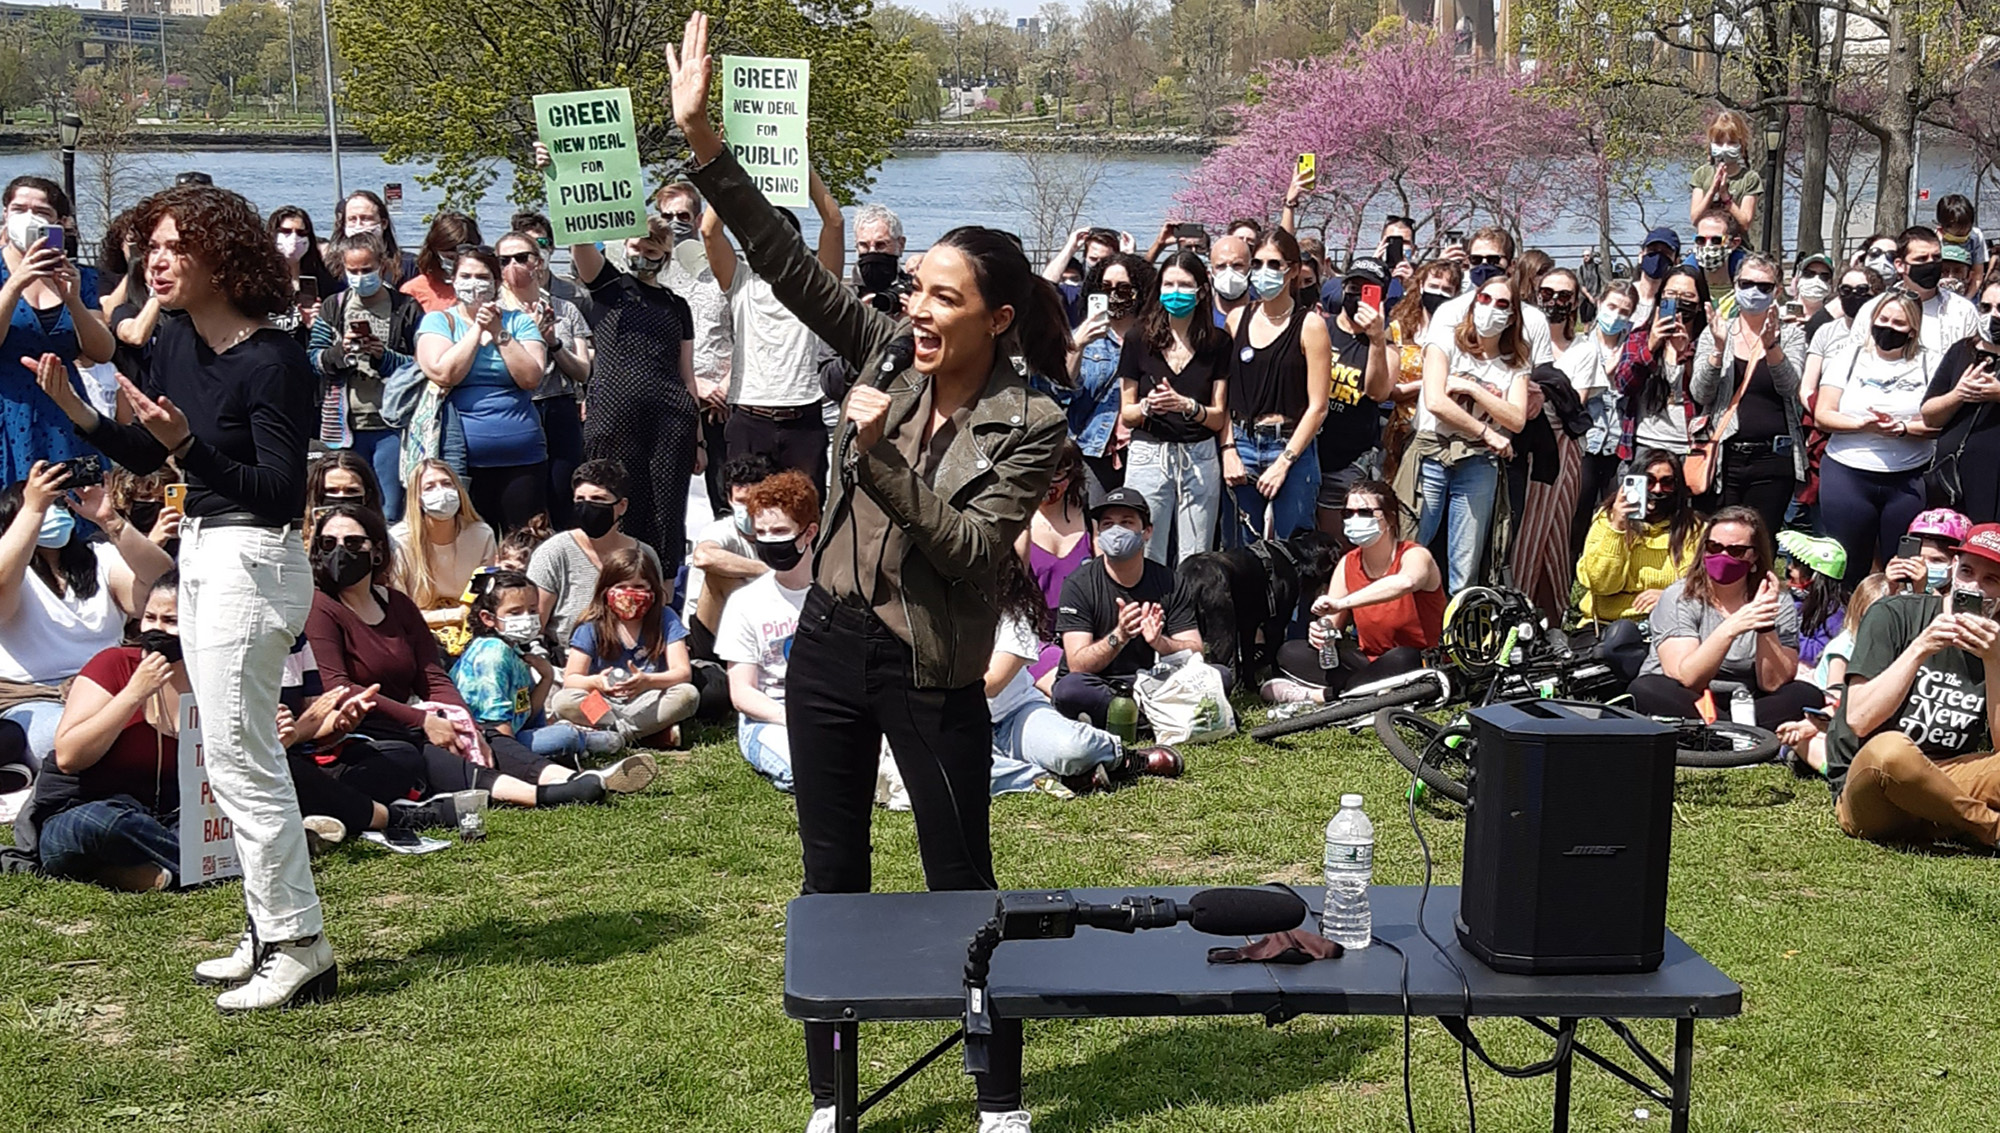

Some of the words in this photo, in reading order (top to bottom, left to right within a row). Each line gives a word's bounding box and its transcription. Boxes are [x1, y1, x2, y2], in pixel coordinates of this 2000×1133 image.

[734, 67, 798, 90] GREEN
[548, 99, 621, 127] GREEN
[733, 99, 764, 115] NEW
[767, 101, 799, 115] DEAL
[756, 124, 778, 137] FOR
[553, 137, 585, 153] NEW
[588, 133, 626, 150] DEAL
[733, 144, 799, 166] PUBLIC
[581, 160, 605, 174] FOR
[560, 180, 632, 206] PUBLIC
[753, 176, 799, 193] USING
[565, 210, 636, 232] HOUSING
[1329, 381, 1362, 407] URY
[1328, 401, 1345, 413] UR
[1945, 672, 1962, 687] The
[1910, 695, 1979, 730] New
[1899, 717, 1969, 750] Deal
[1563, 845, 1626, 855] BOSE
